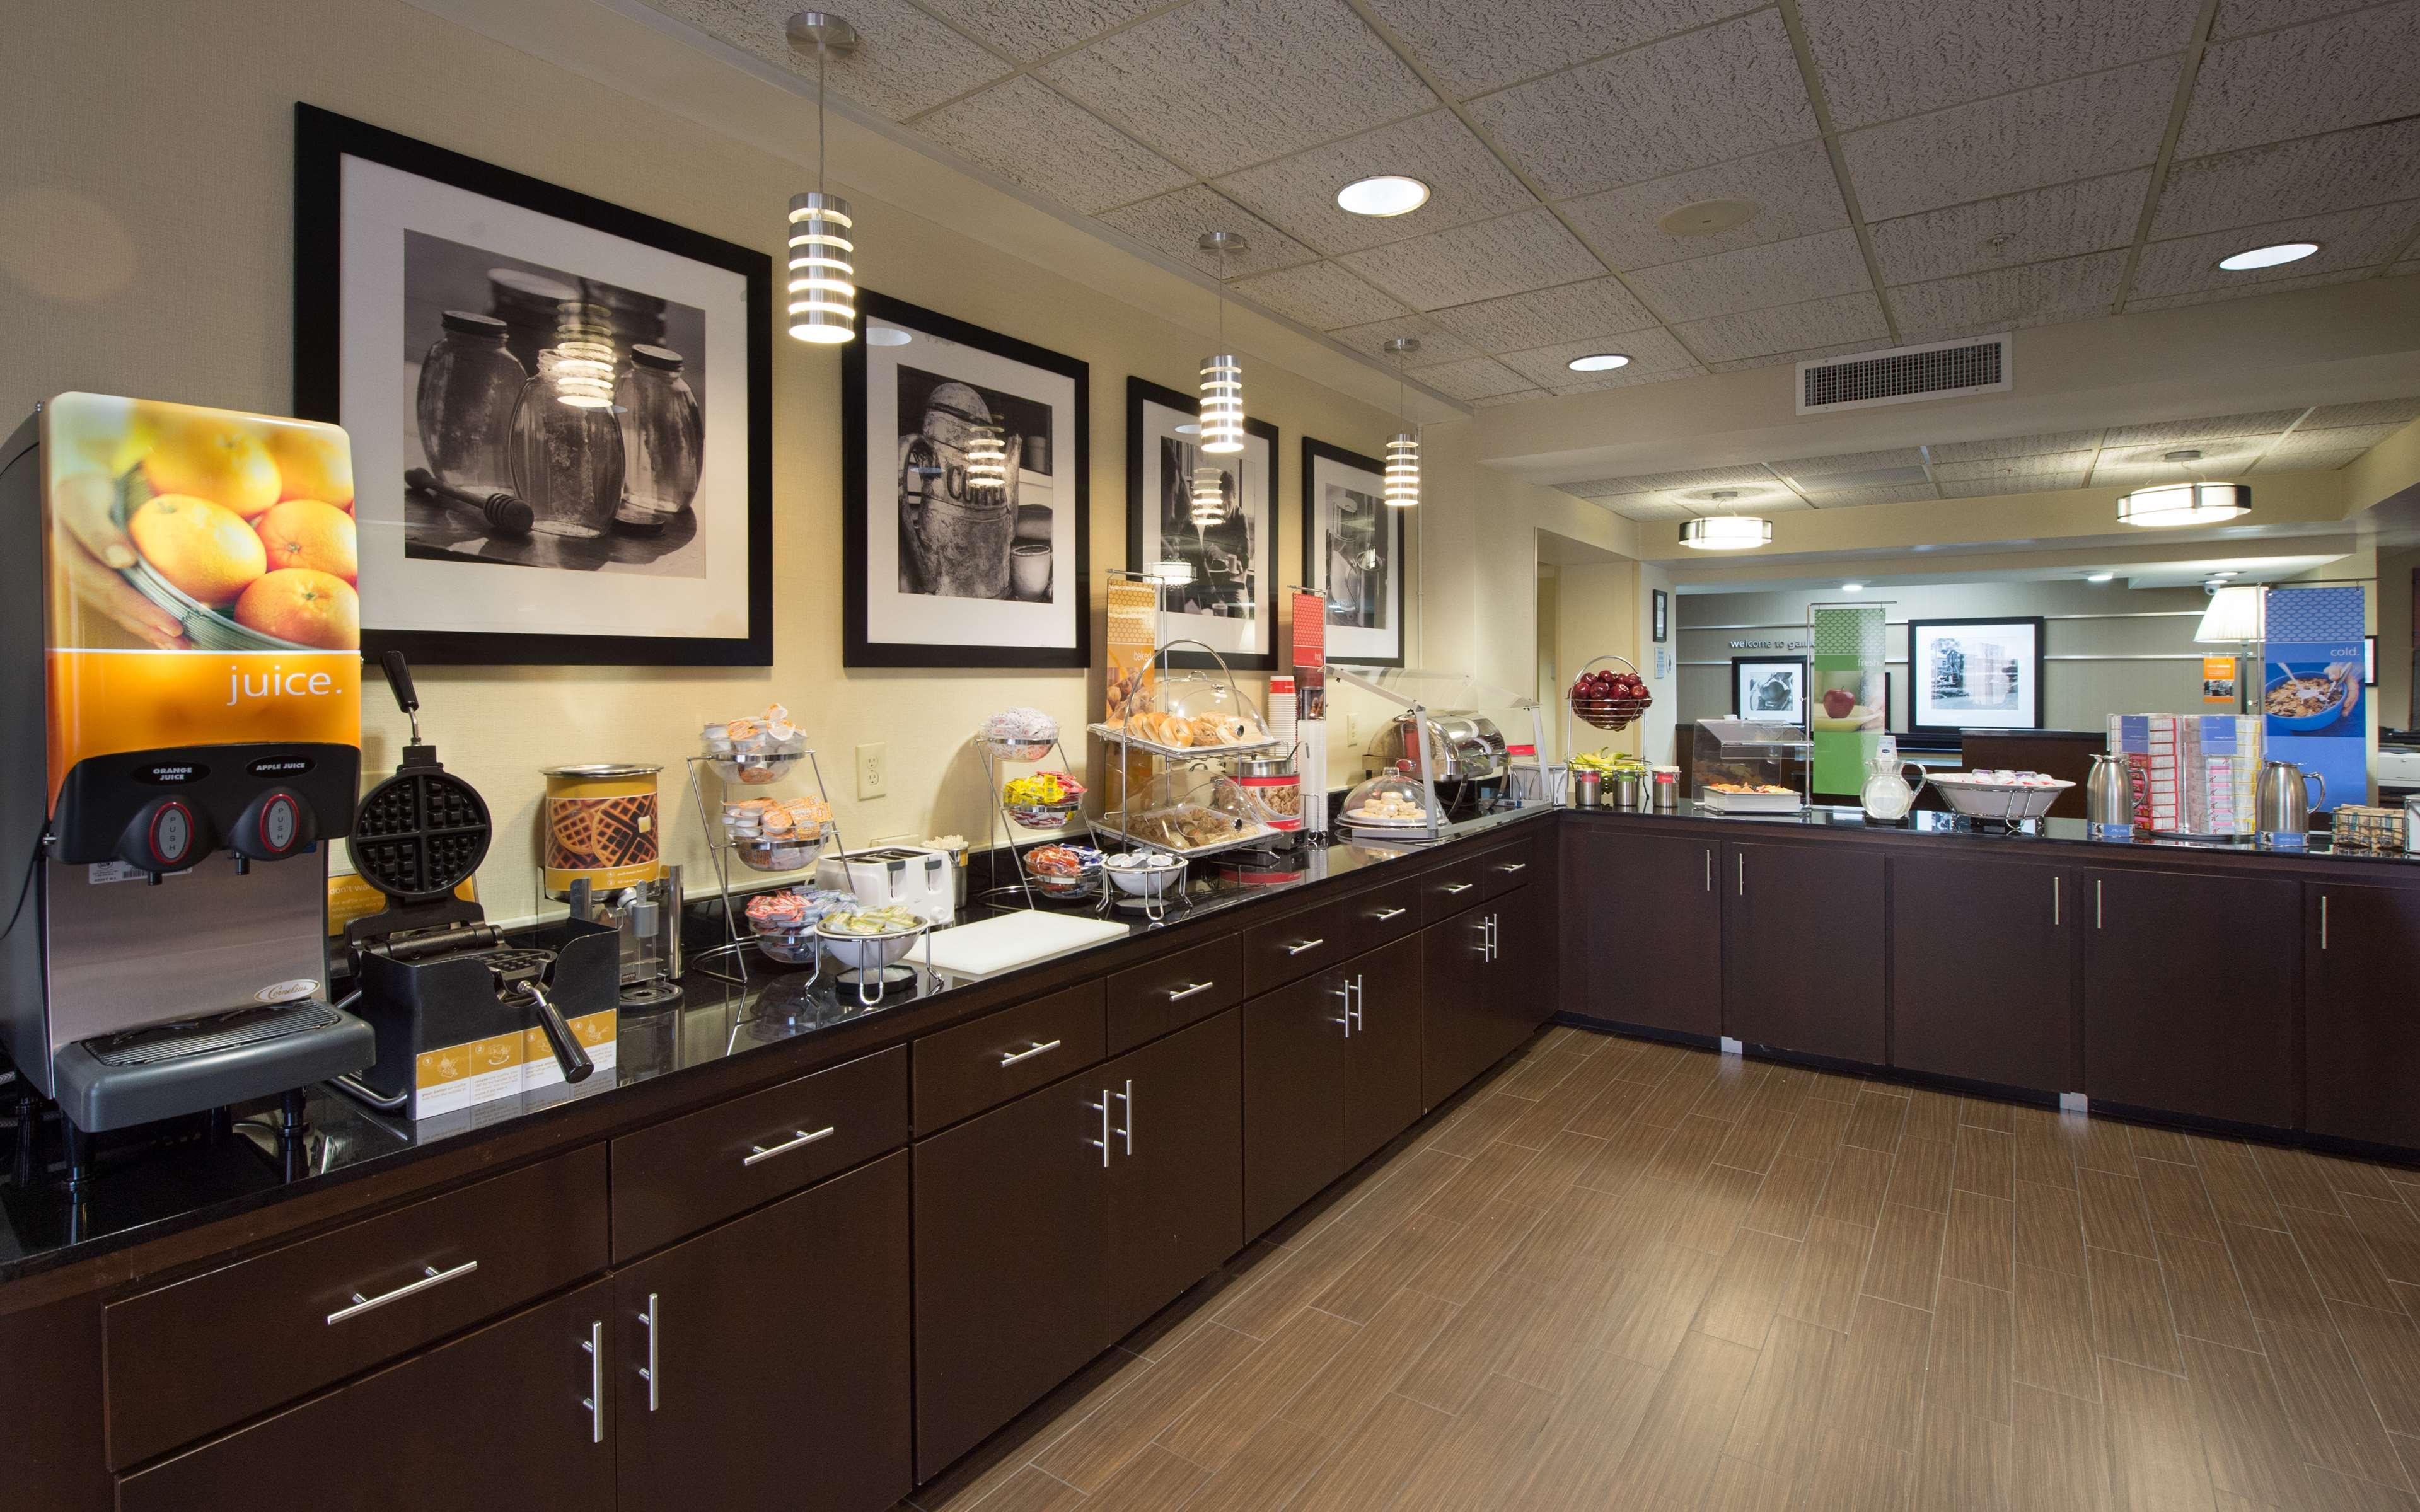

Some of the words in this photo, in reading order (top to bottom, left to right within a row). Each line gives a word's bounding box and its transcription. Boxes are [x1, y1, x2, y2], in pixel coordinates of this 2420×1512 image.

[1730, 639, 1772, 648] welcome
[2330, 647, 2360, 656] cold.
[226, 665, 342, 706] juice.
[153, 767, 192, 775] ORANGE
[256, 763, 281, 771] APPLE
[168, 817, 177, 851] PUSH
[329, 886, 353, 895] don't
